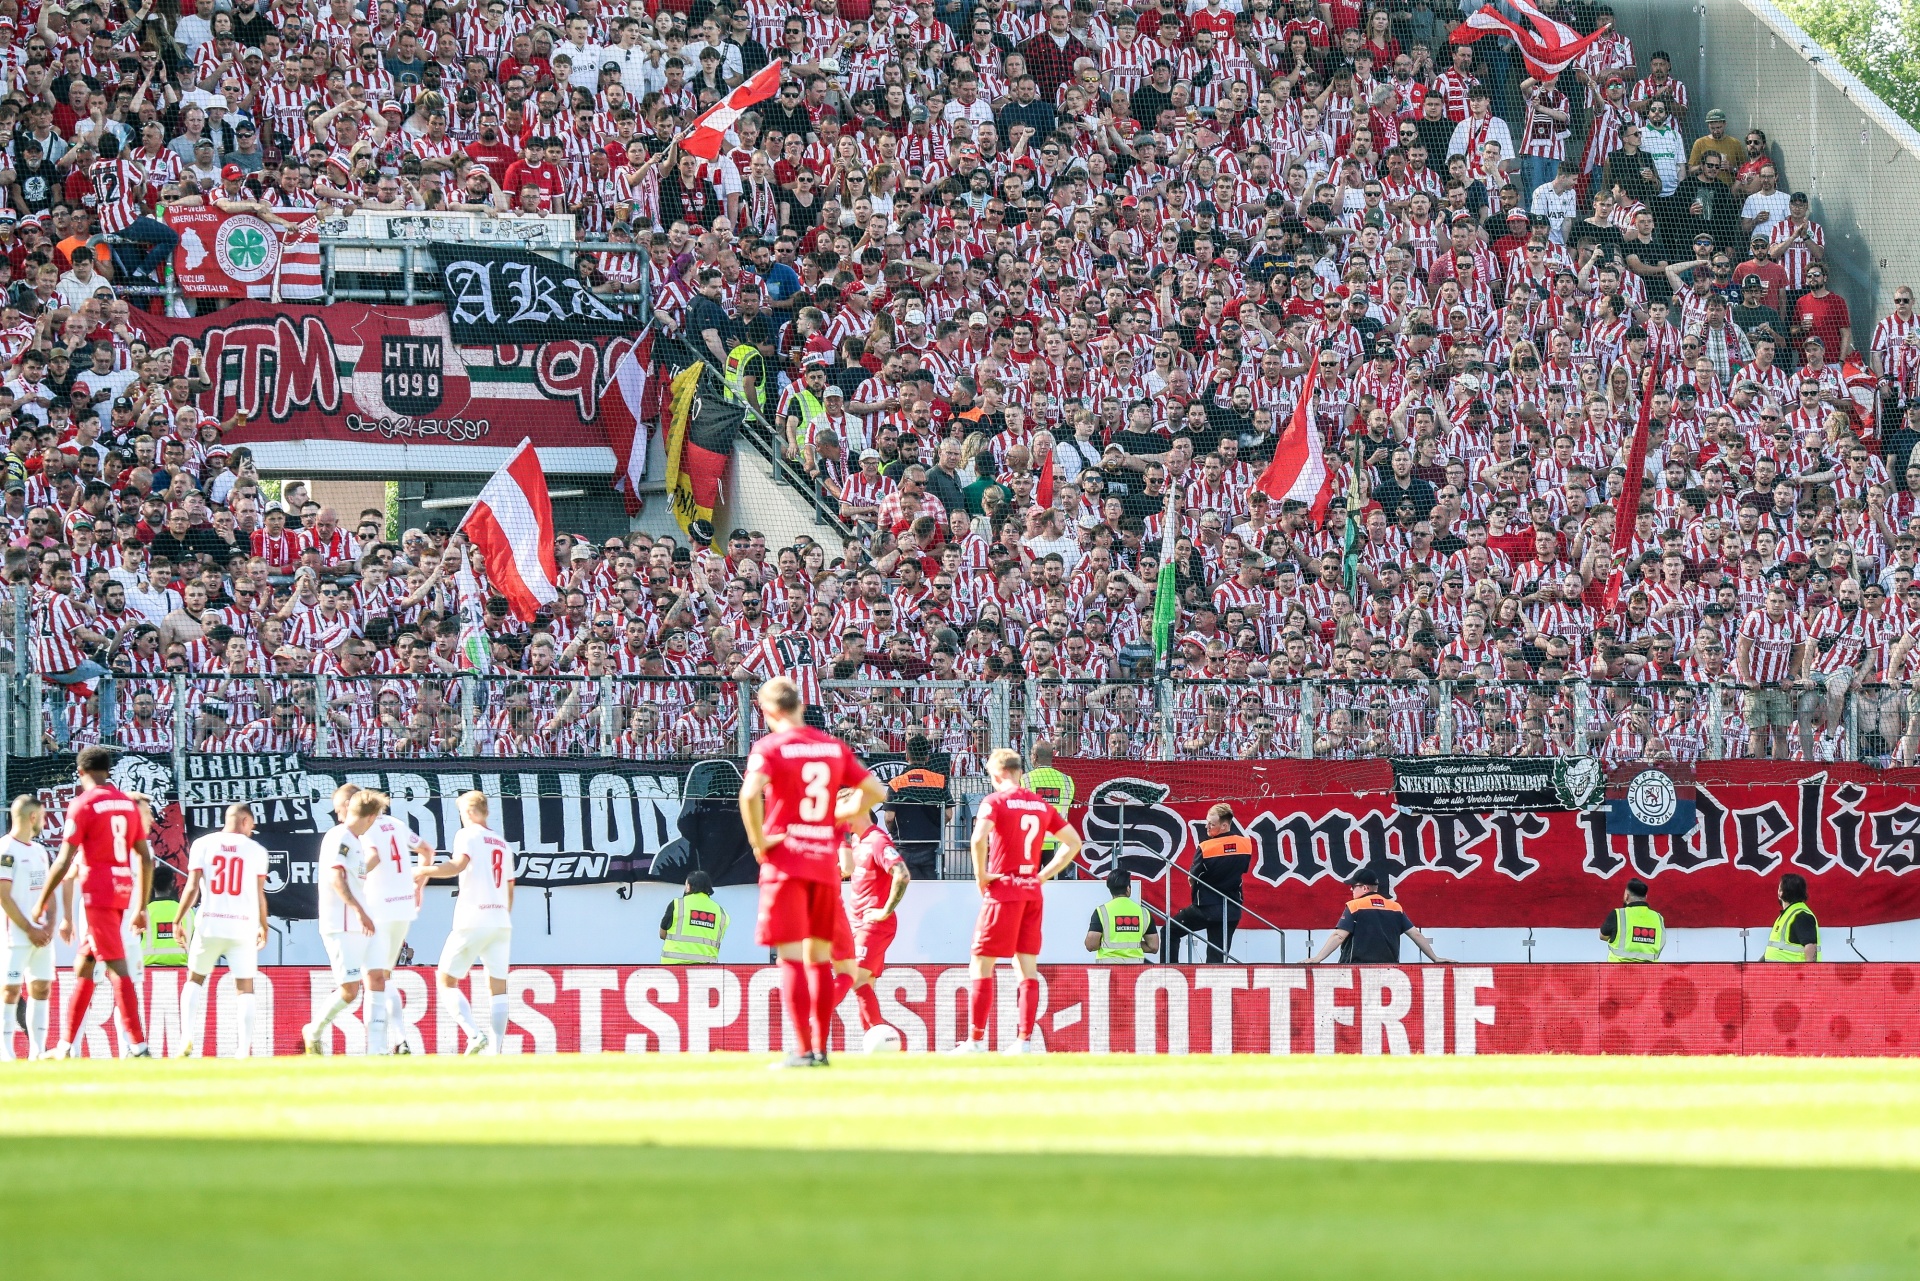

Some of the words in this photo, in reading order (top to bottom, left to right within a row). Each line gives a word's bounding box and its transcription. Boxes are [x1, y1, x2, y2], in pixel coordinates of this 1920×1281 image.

[92, 173, 120, 203] 12
[172, 213, 218, 224] OBERHAUSEN
[224, 263, 236, 276] SC
[385, 342, 440, 368] HTM
[384, 373, 440, 398] 1999
[776, 636, 814, 668] 12
[1434, 765, 1460, 774] Brüder
[1453, 774, 1548, 794] STADIONVERBOT
[190, 771, 305, 804] SOCIETY
[799, 761, 830, 822] 3
[1628, 772, 1676, 804] WUPPERTAL
[194, 798, 308, 828] ULRAS
[301, 773, 686, 855] RBELLION
[1636, 812, 1672, 824] ASOZIAL
[110, 814, 128, 862] 8
[390, 834, 401, 873] 4
[1081, 775, 1550, 902] Smper
[211, 855, 244, 896] 30
[492, 849, 502, 888] 8
